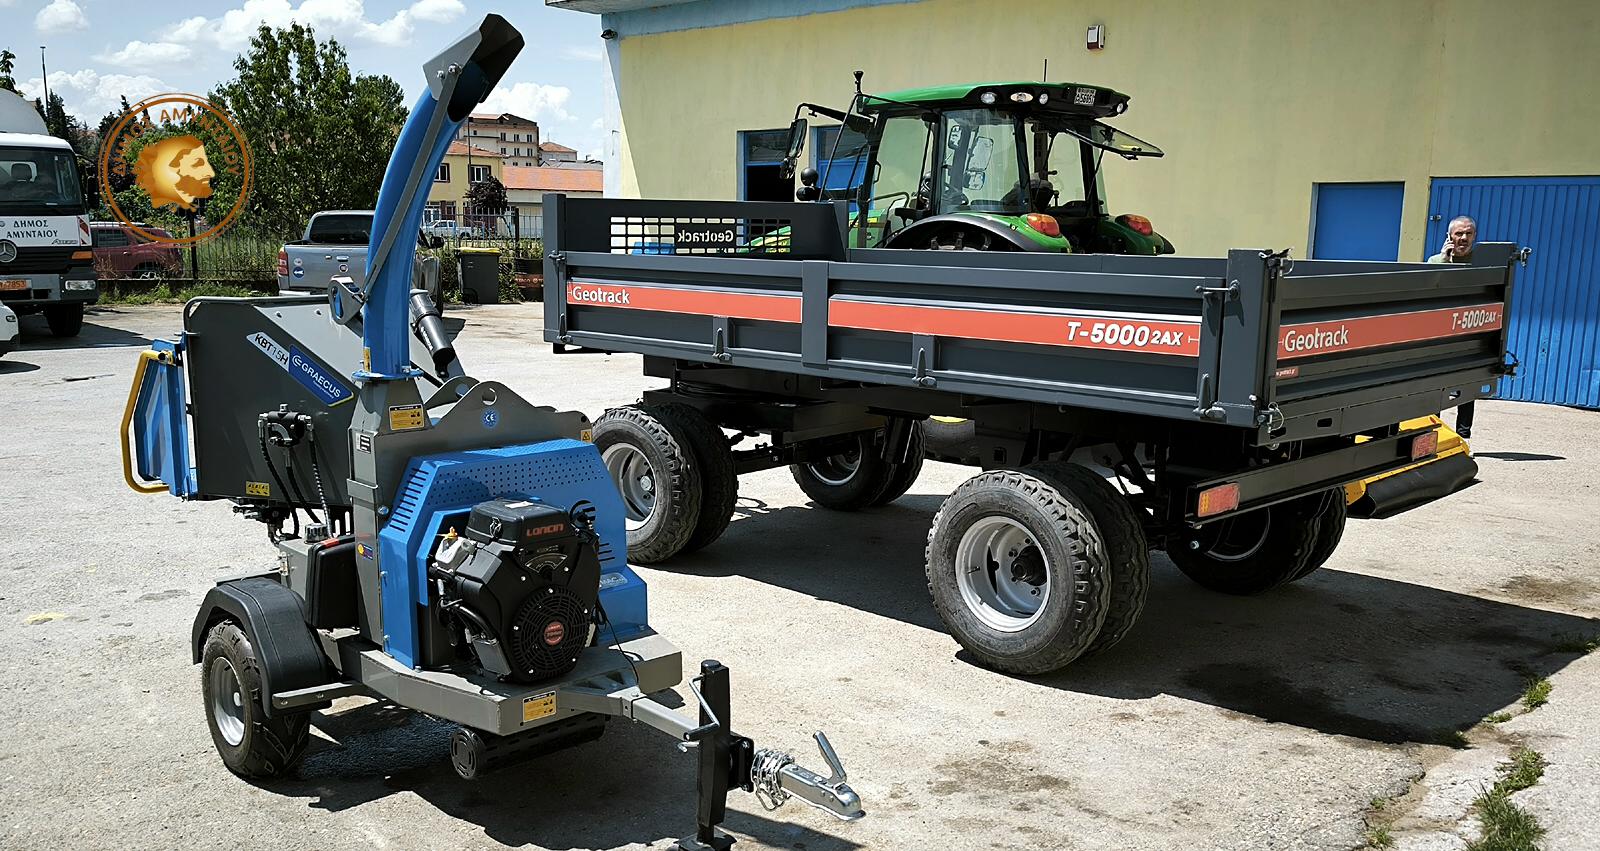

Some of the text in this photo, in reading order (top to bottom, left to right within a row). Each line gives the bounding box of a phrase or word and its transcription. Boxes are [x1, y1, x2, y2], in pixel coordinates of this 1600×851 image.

[6, 230, 58, 238] ΑΜΥΝΤΑΙΟΥ
[13, 220, 48, 228] ΔΗΜΟΣ
[572, 286, 630, 305] Geotrack
[1067, 321, 1150, 347] T-5000
[1284, 324, 1349, 352] Geotrack
[301, 362, 341, 398] GRAECUS
